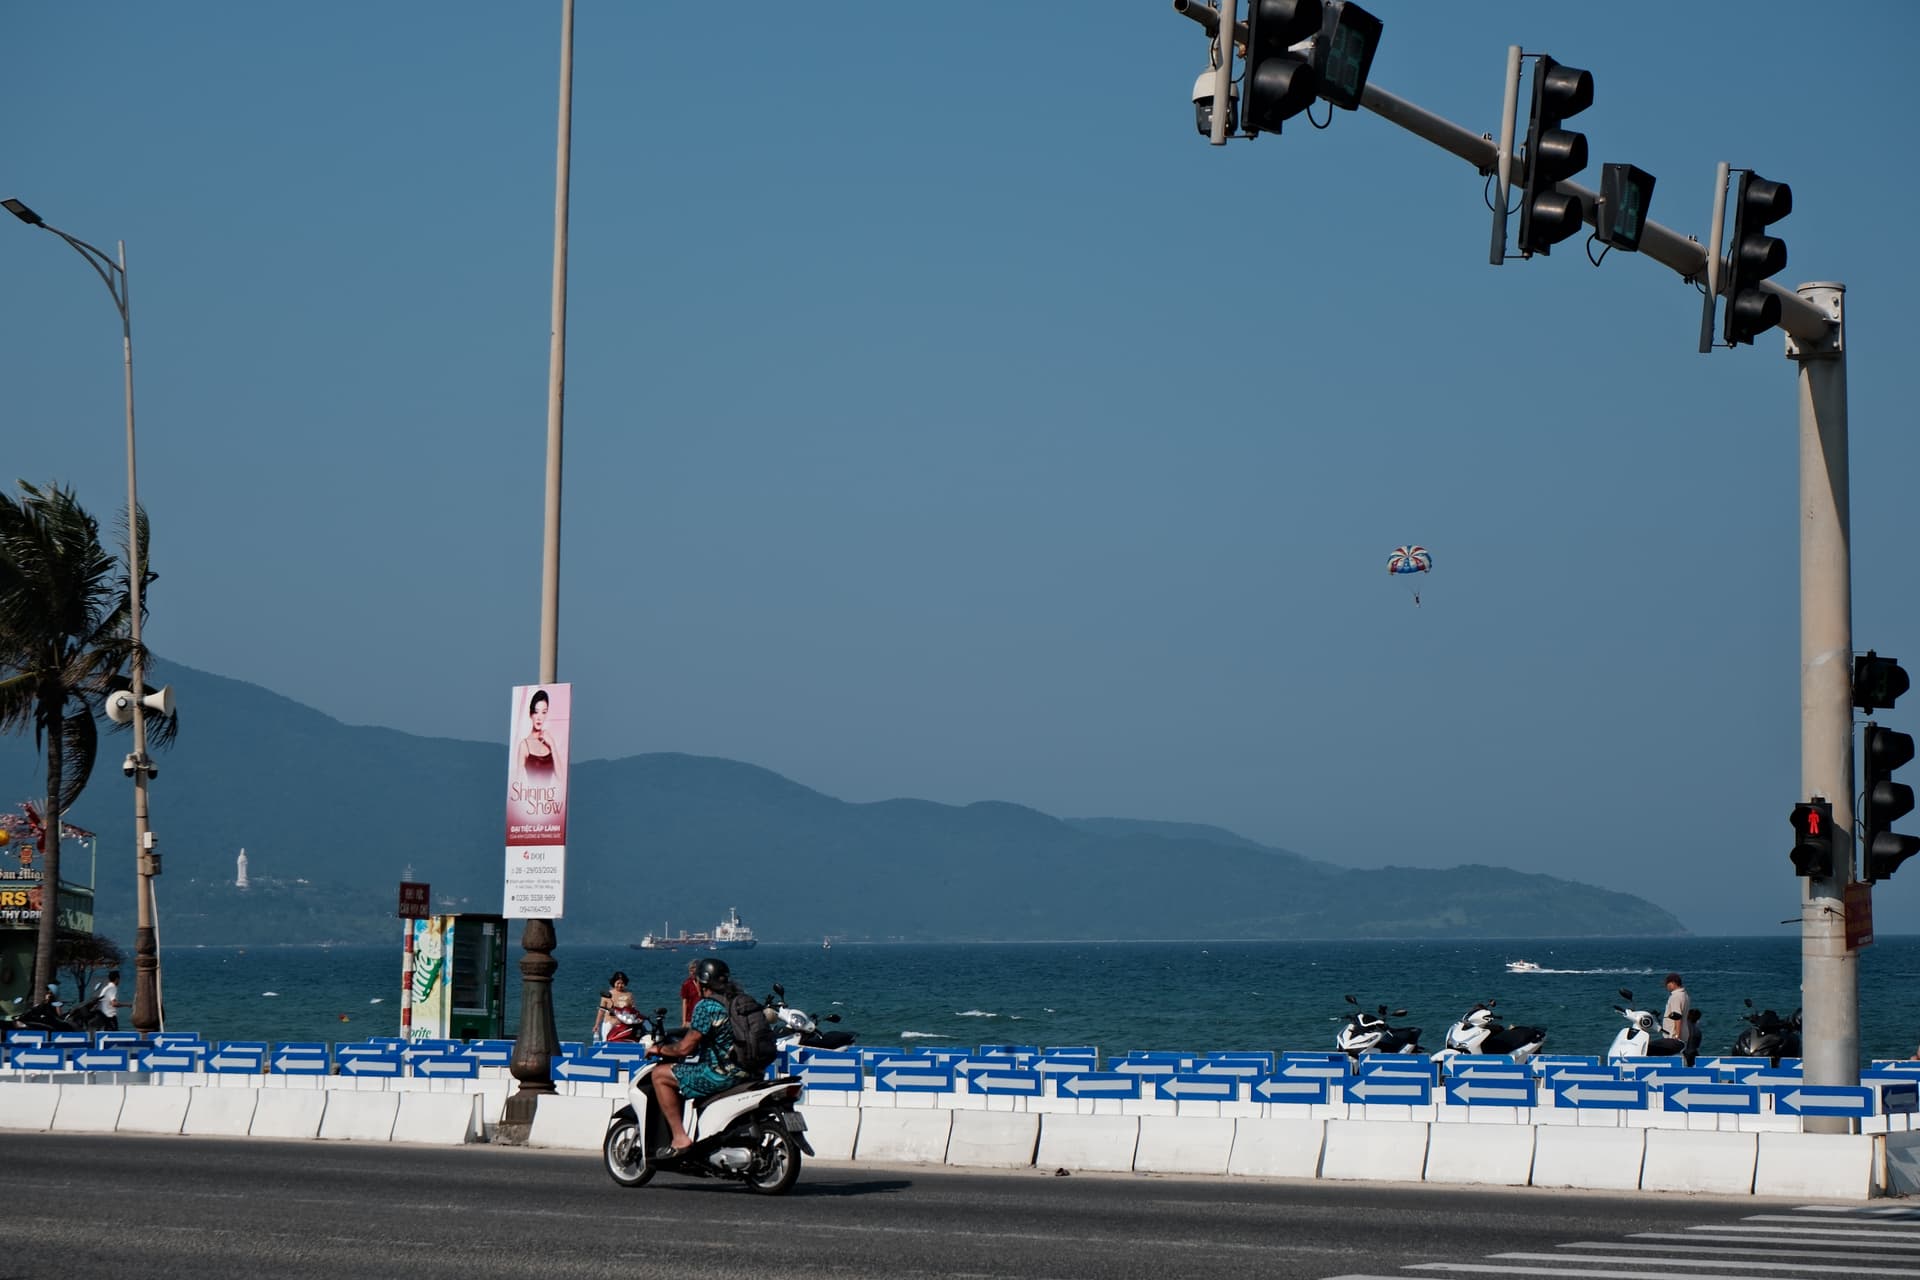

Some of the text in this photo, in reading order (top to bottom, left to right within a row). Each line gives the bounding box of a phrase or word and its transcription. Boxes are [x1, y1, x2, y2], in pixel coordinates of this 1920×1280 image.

[526, 797, 563, 814] Show
[0, 891, 27, 906] RS
[0, 910, 21, 919] THY
